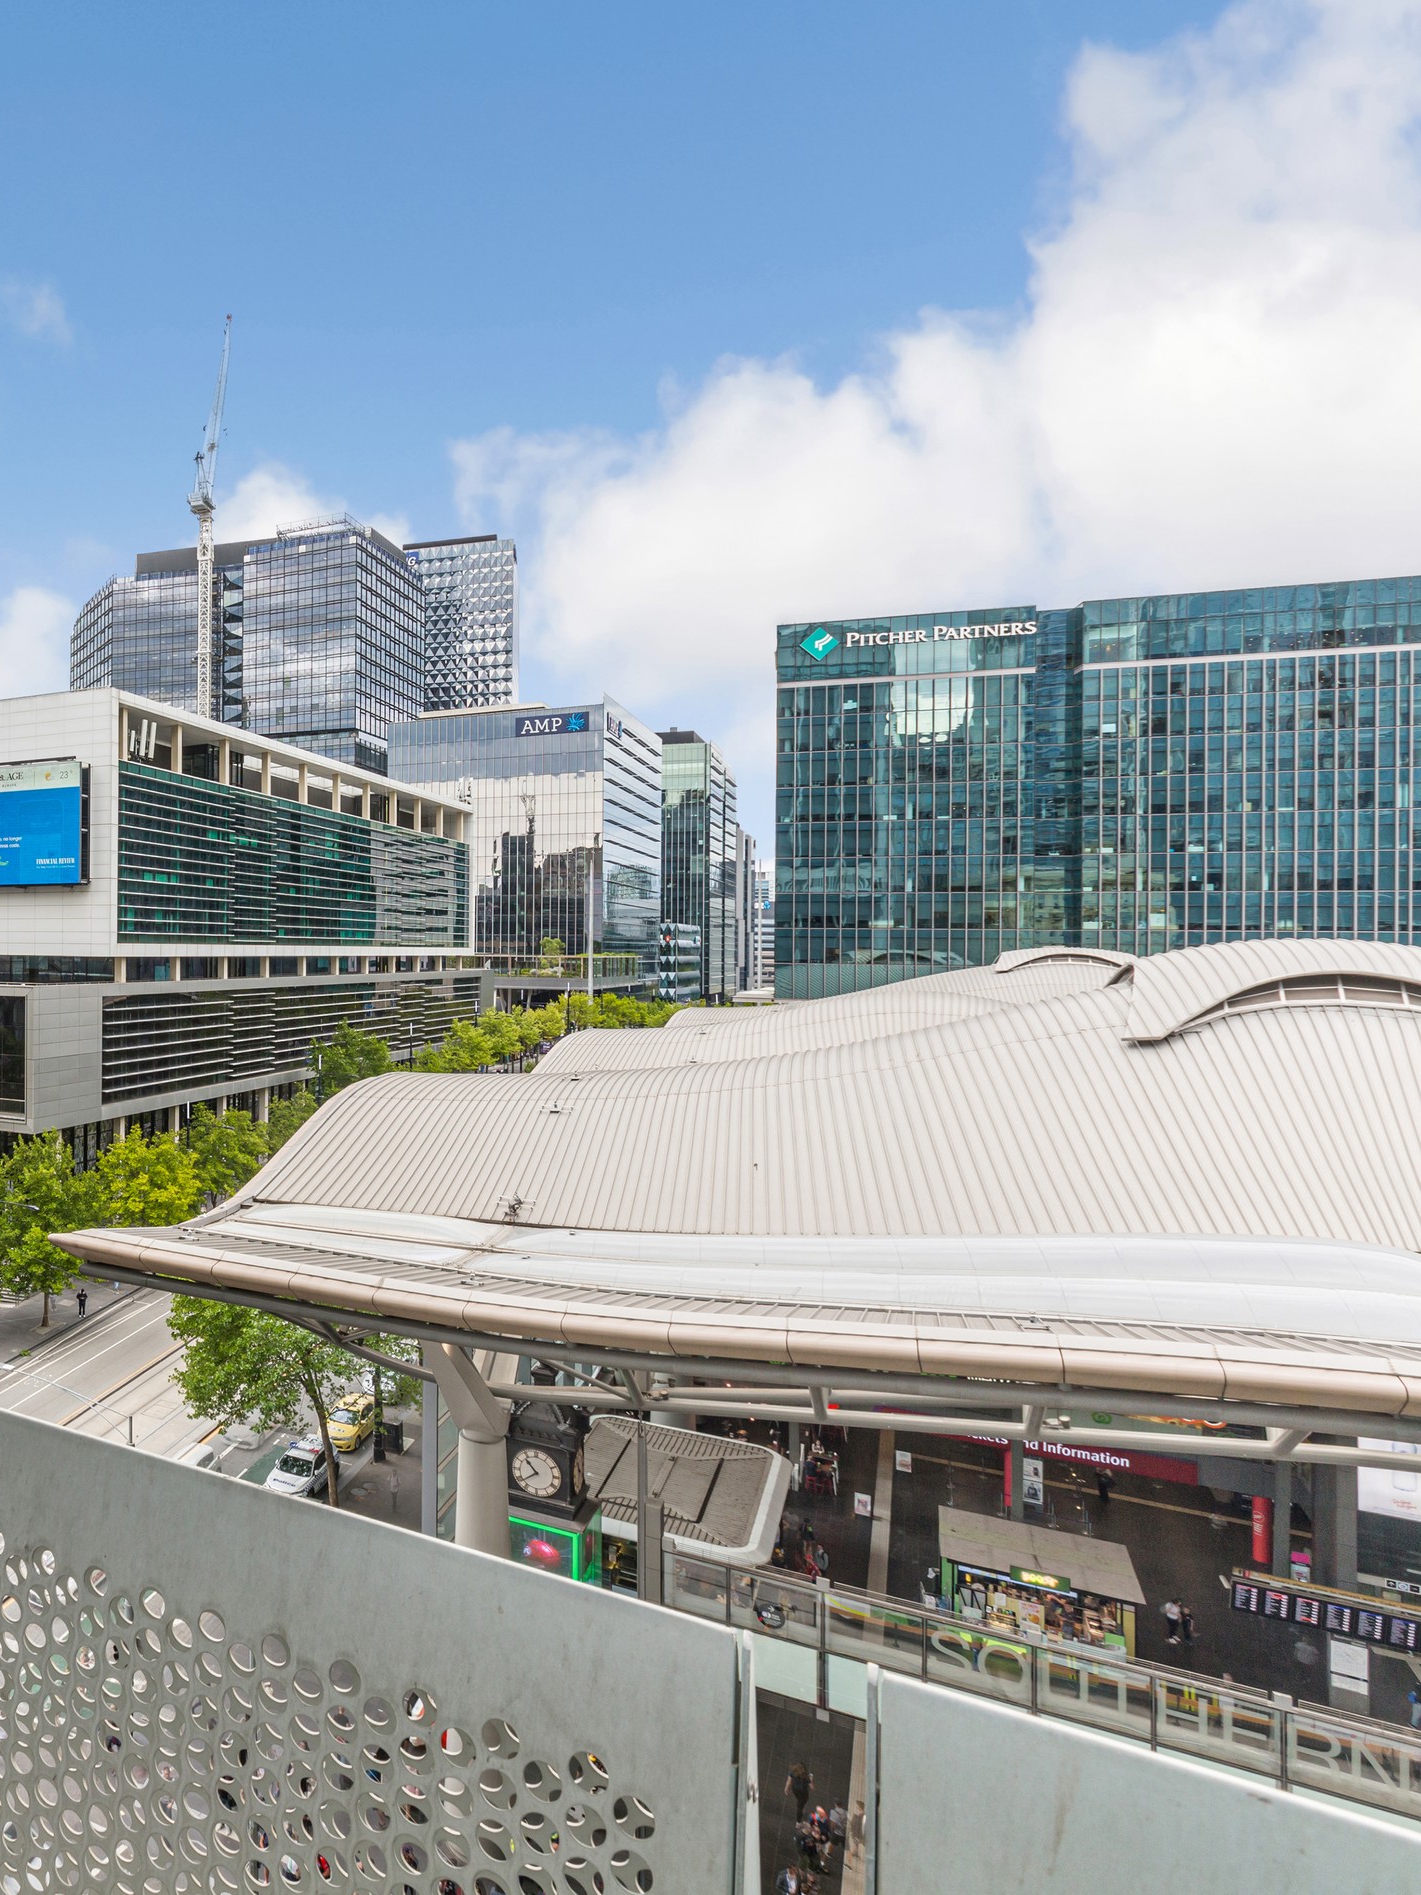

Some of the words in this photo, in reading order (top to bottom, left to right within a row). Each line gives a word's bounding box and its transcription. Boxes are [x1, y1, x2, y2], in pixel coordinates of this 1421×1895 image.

[845, 629, 929, 648] PITCHER
[933, 621, 1038, 641] PARTNERS
[521, 717, 562, 735] AMP
[7, 772, 24, 781] AGE
[1023, 1440, 1038, 1451] nd
[1043, 1441, 1131, 1468] Information
[926, 1629, 1412, 1793] SOUTHERN
